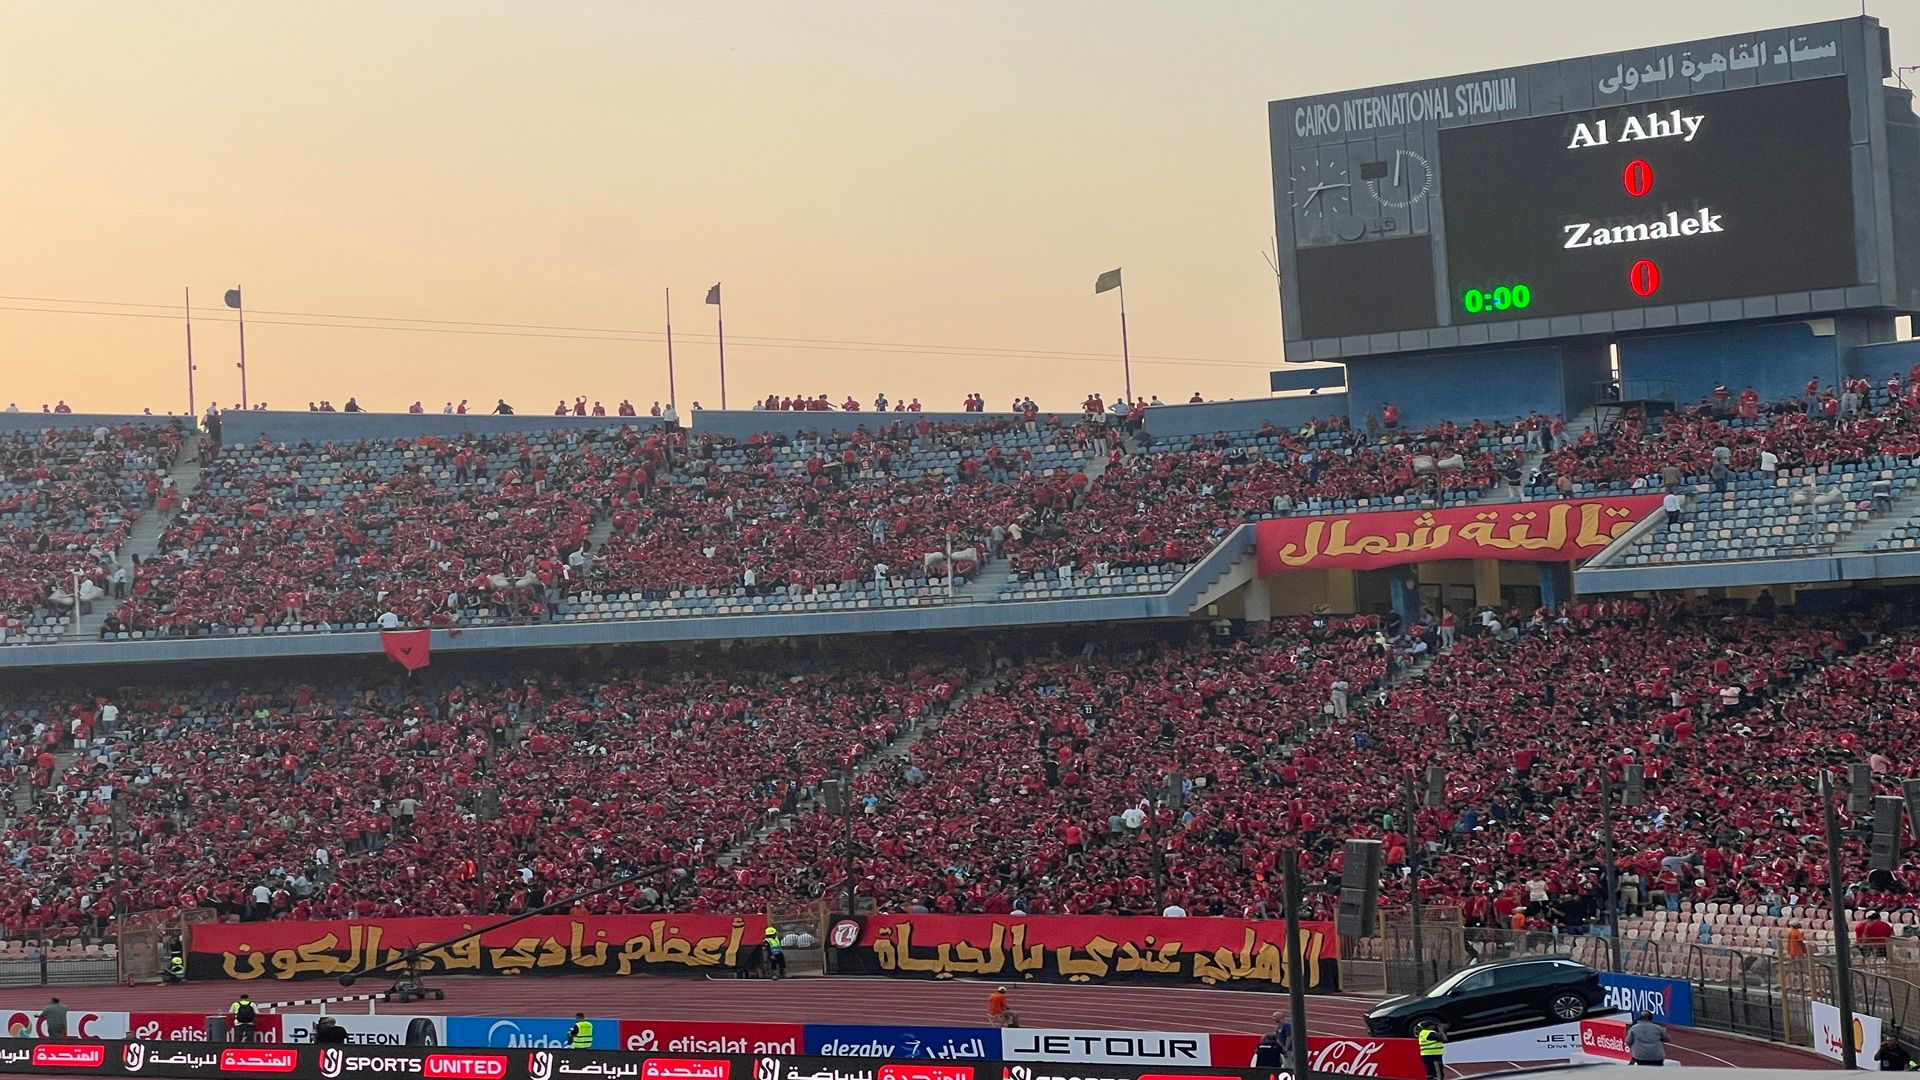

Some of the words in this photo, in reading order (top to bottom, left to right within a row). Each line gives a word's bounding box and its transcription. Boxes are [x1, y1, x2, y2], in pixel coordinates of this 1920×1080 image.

[1680, 43, 1767, 82] القاهرة
[1773, 36, 1837, 65] ستاد
[1295, 103, 1341, 137] CAIRO
[1344, 86, 1454, 132] INTERNATIONAL
[1455, 77, 1517, 116] STADIUM
[1567, 119, 1609, 149] Al
[1617, 109, 1705, 142] Ahly
[1624, 159, 1653, 197] 0
[1563, 207, 1725, 249] Zamalek
[1630, 259, 1660, 296] 0
[1464, 284, 1532, 314] 0:00
[1278, 511, 1452, 567] شمال
[222, 924, 384, 980] الكون
[490, 920, 608, 976] نادي
[616, 917, 746, 975] أعظم
[1056, 935, 1182, 983] عندي
[37, 1048, 99, 1062] المتحدة
[150, 1050, 217, 1069] للرياضة
[225, 1053, 292, 1067] المتحدة
[668, 1035, 748, 1053] etisalat
[753, 1038, 796, 1055] and
[1013, 1035, 1198, 1059] JETOUR
[346, 1056, 422, 1073] SPORTS
[430, 1059, 503, 1076] UNITED
[559, 1060, 638, 1080] للرياضة
[647, 1063, 724, 1079] المتحدة
